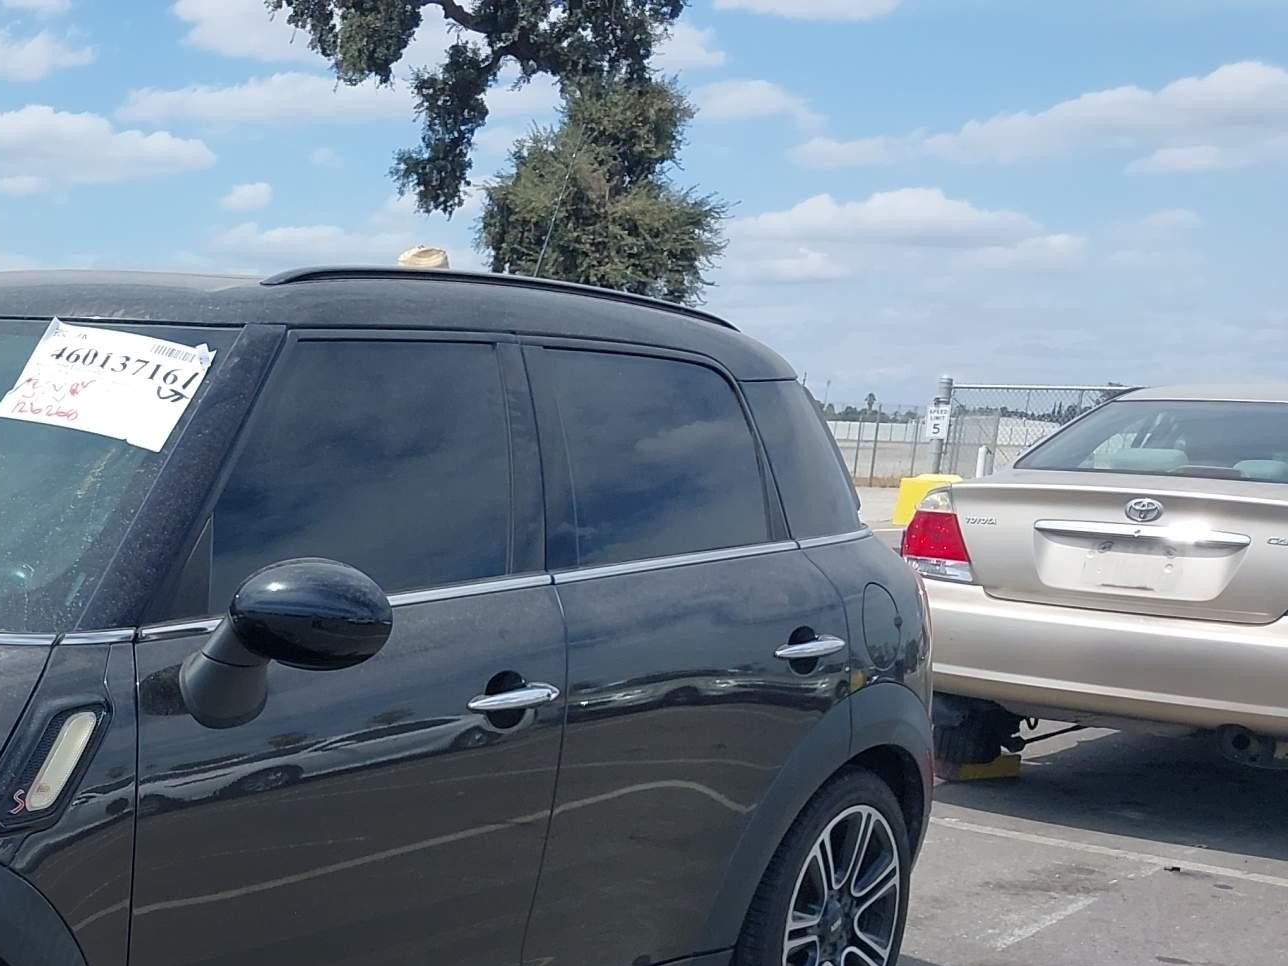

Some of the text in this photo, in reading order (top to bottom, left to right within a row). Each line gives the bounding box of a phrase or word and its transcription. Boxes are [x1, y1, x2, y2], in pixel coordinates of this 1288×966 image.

[931, 423, 940, 434] 5
[964, 516, 997, 526] TOYOTA
[10, 789, 26, 815] S
